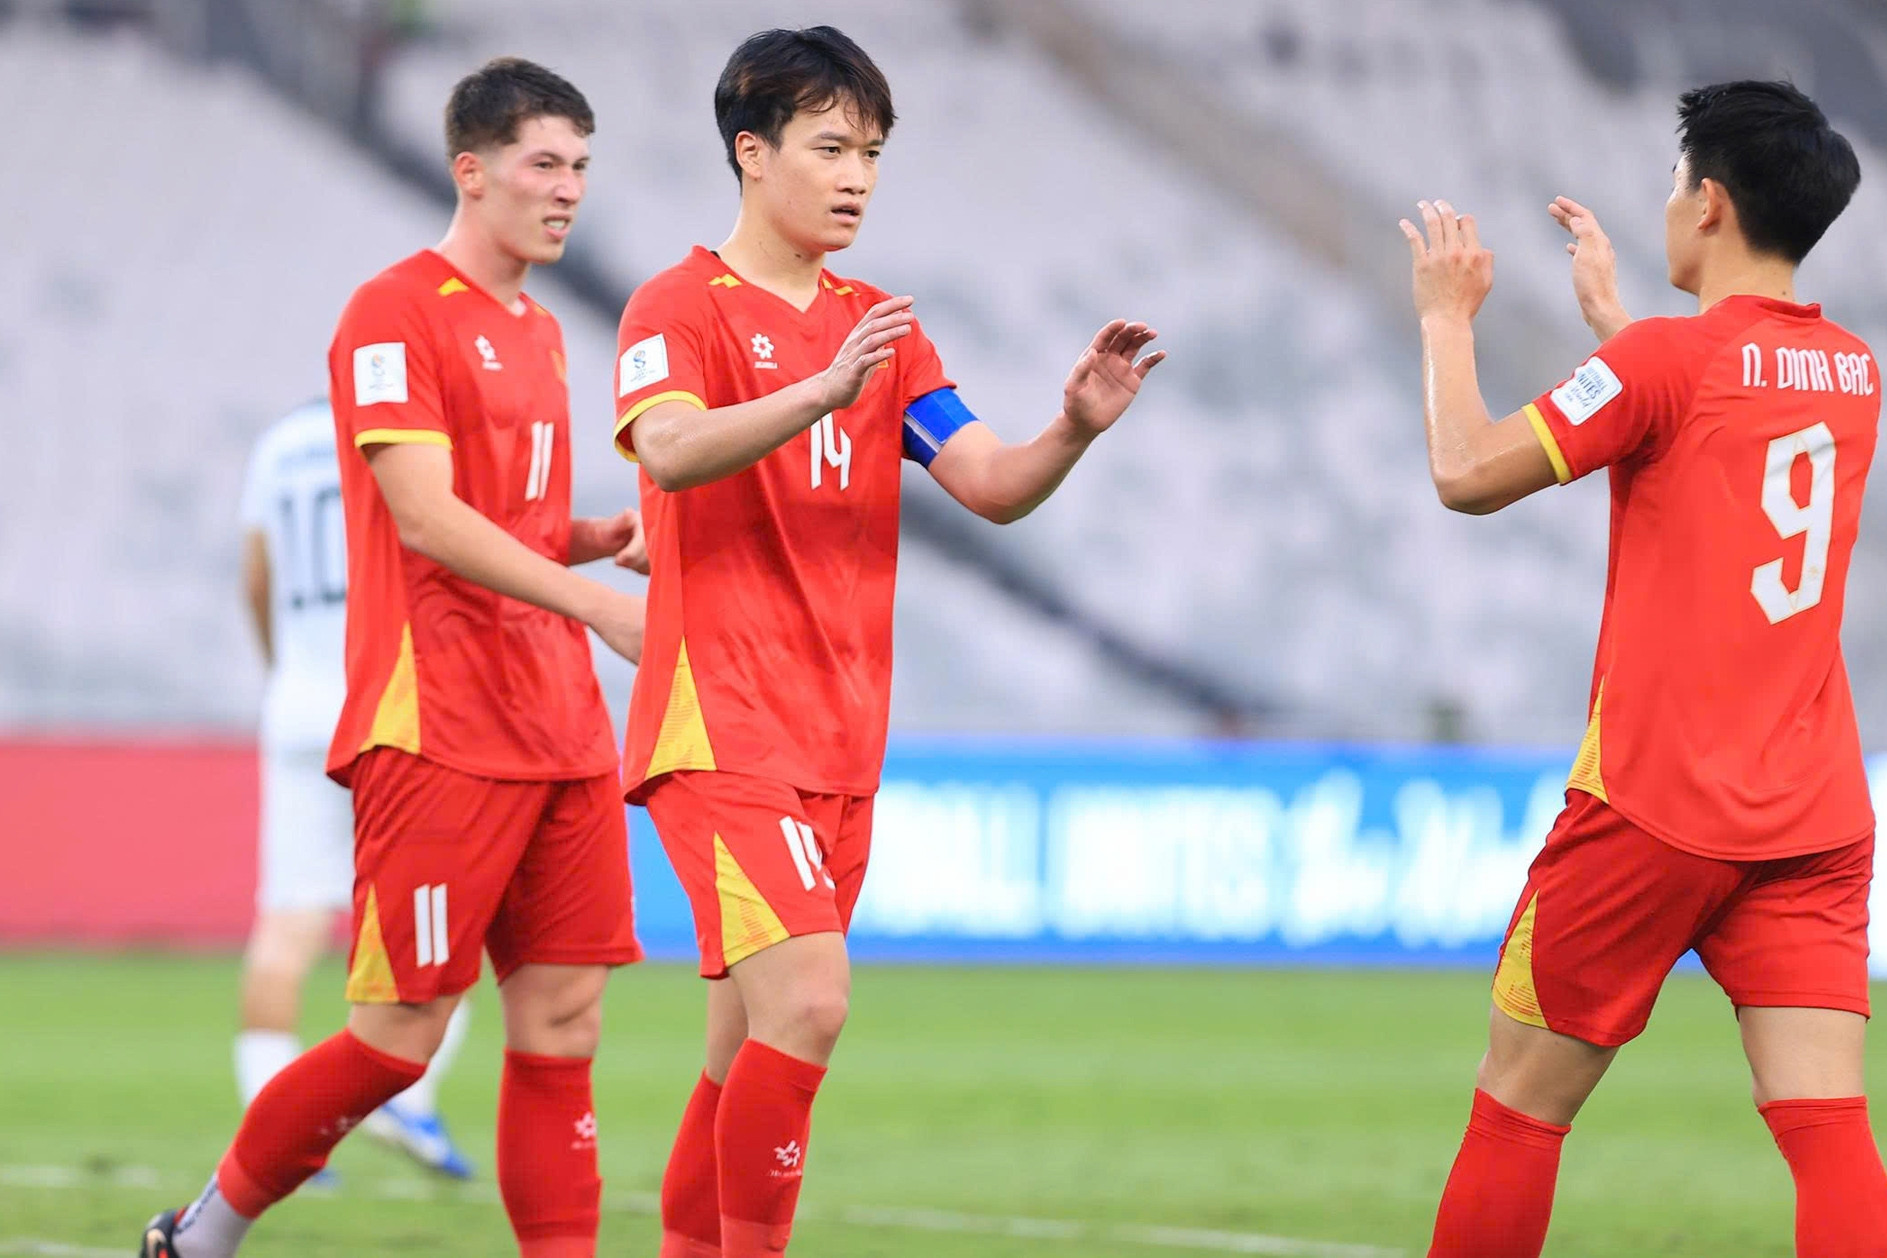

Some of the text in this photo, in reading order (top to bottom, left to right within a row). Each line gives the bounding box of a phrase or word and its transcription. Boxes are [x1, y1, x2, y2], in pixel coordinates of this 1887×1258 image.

[1741, 342, 1874, 396] N. DINH BAC
[525, 420, 555, 501] 11
[810, 412, 852, 491] 14
[1750, 421, 1837, 625] 9
[414, 882, 450, 968] 11
